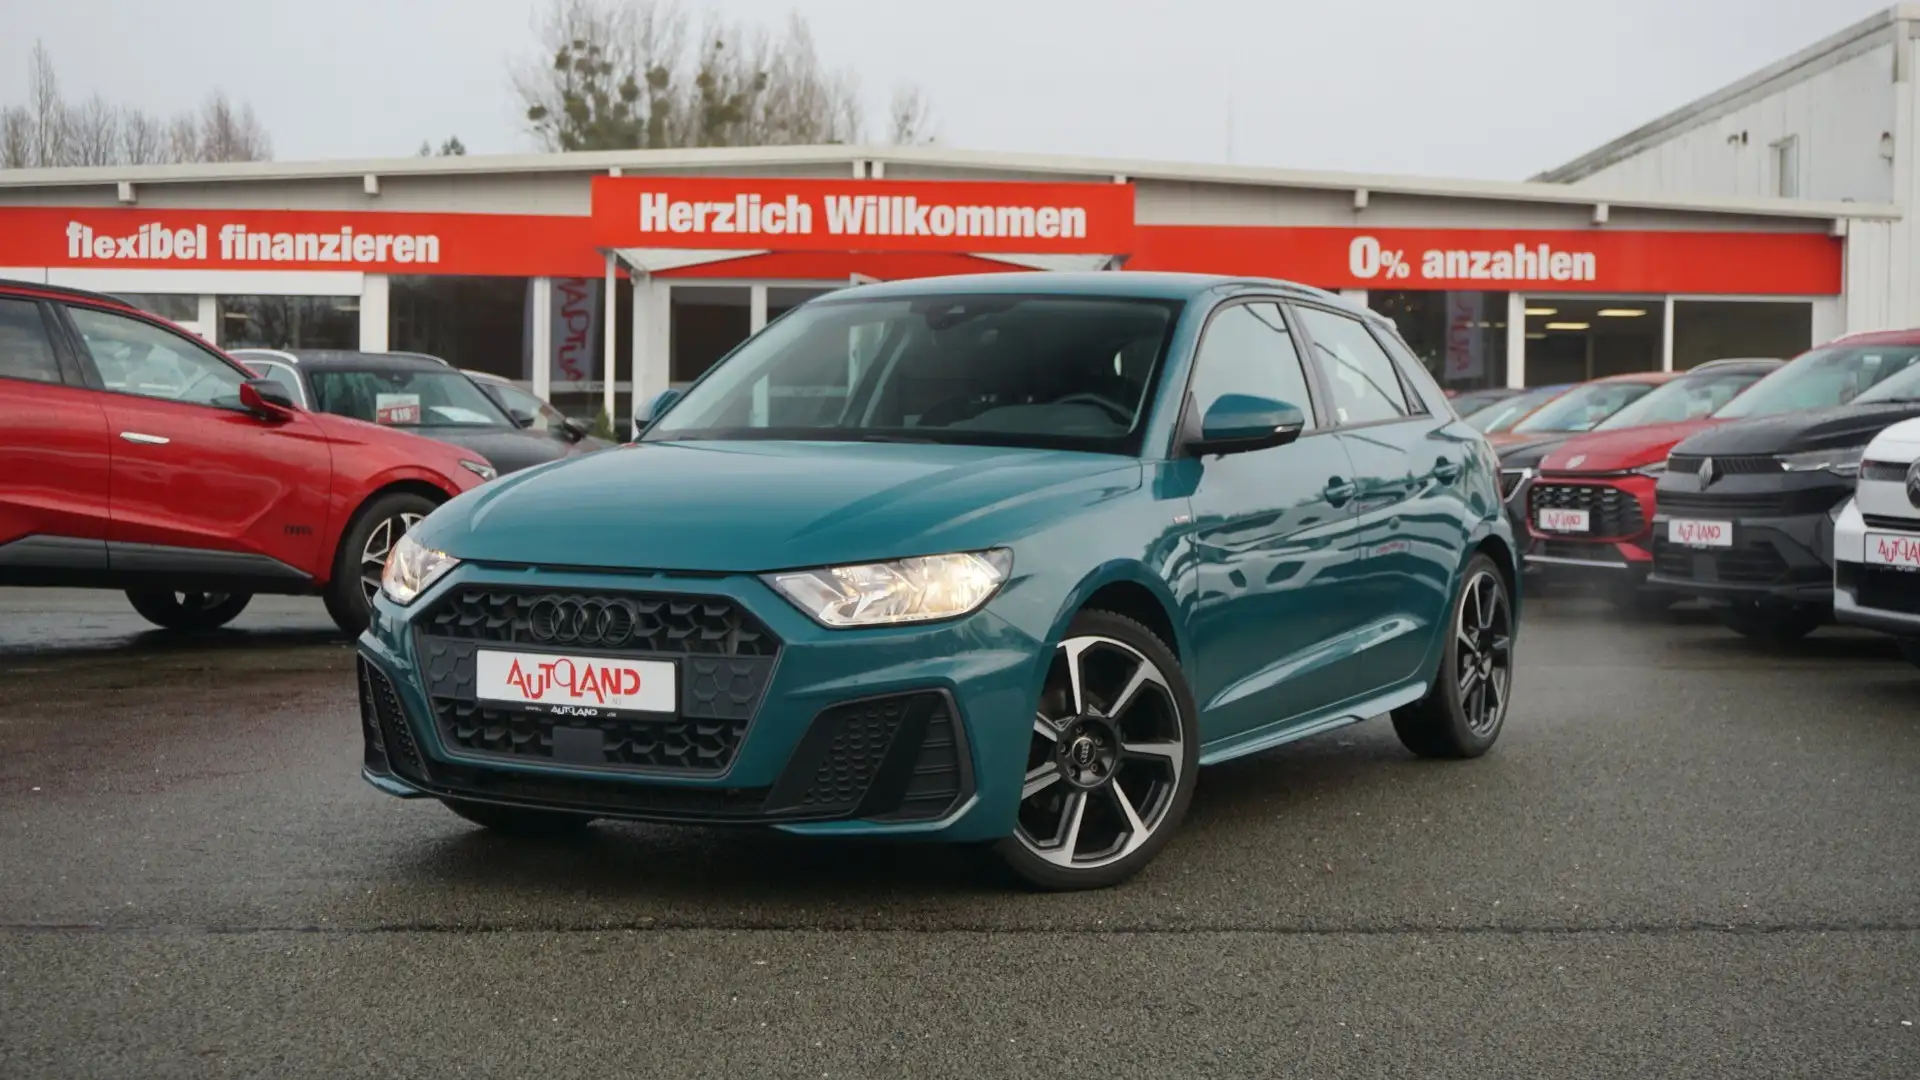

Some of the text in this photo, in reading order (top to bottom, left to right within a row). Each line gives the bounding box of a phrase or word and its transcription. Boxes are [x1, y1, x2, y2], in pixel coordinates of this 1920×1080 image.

[639, 193, 1087, 239] Herzlich Willkommen
[66, 221, 439, 263] flexibel finanzieren
[1349, 235, 1596, 281] 0% anzahlen
[1877, 536, 1920, 566] AUTOLA
[506, 657, 641, 704] AUTOLAND
[550, 705, 598, 717] AUTOLAND
